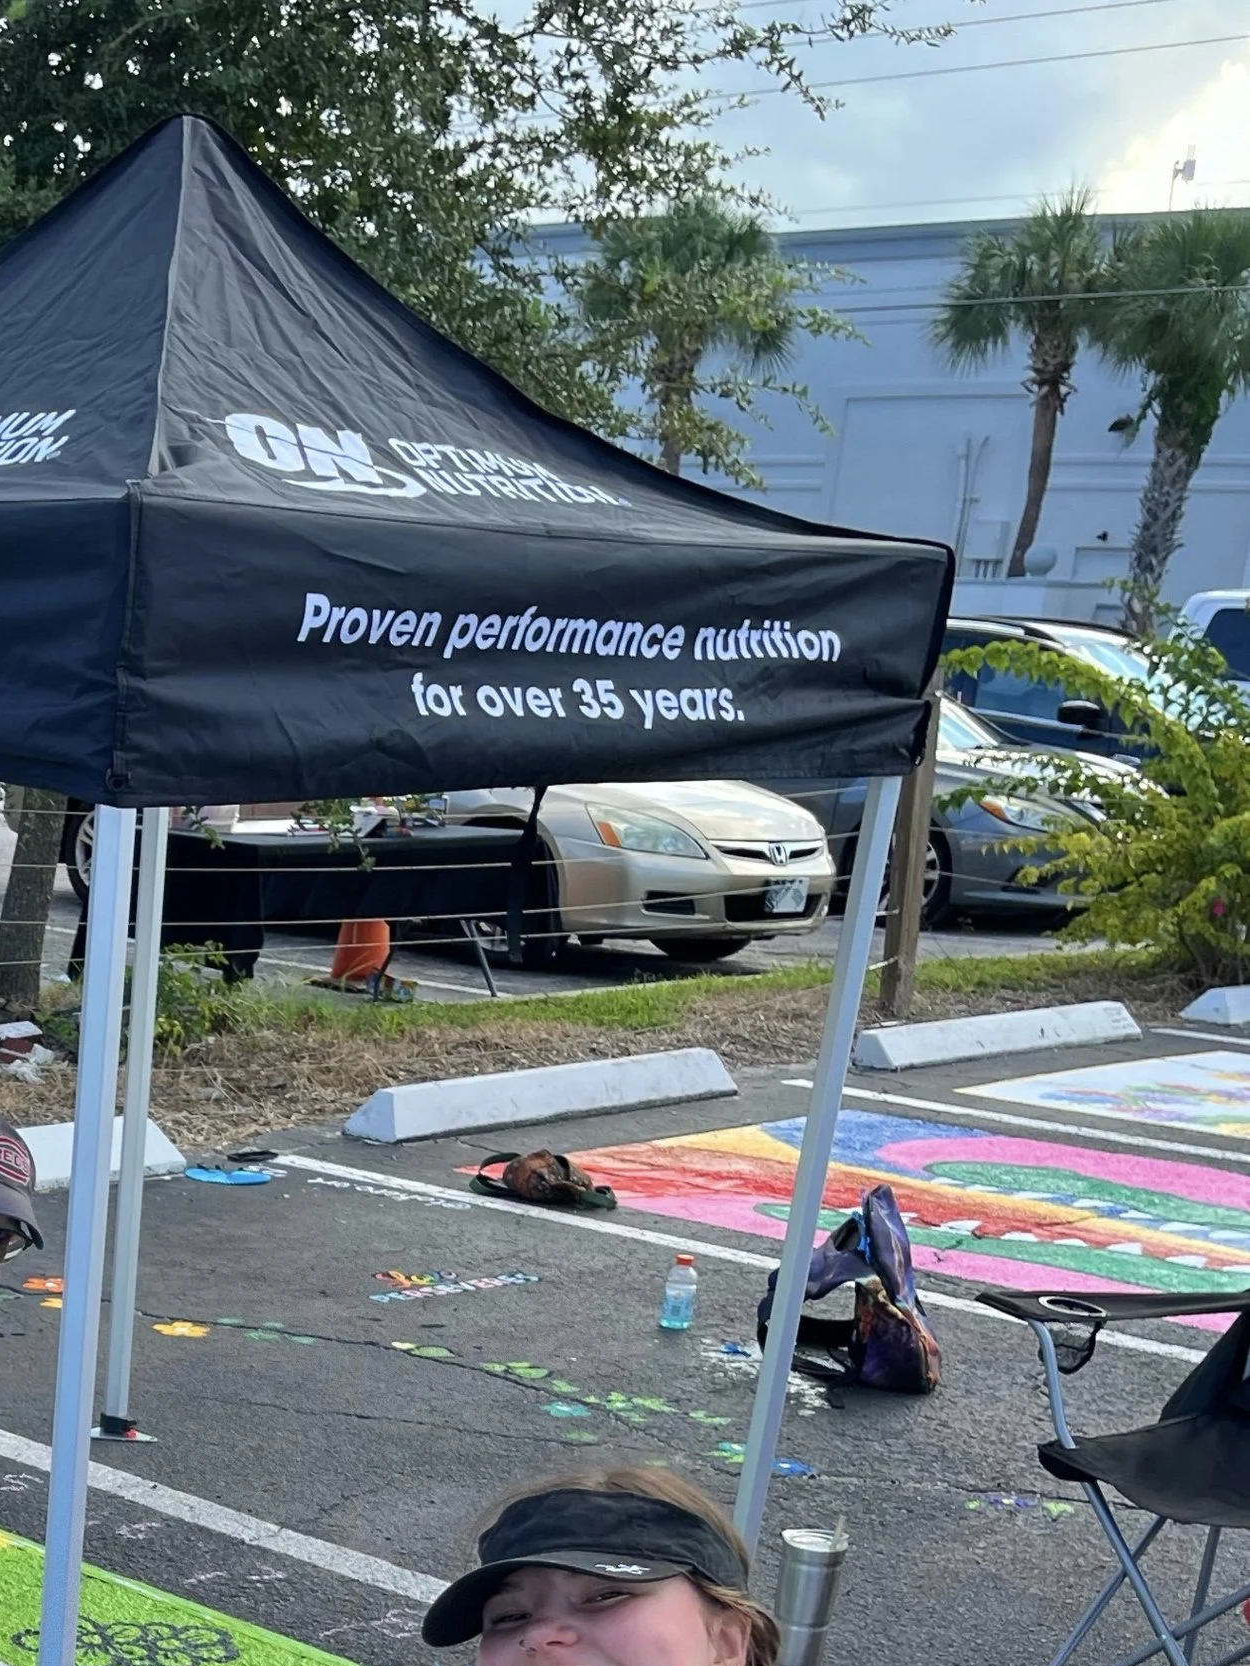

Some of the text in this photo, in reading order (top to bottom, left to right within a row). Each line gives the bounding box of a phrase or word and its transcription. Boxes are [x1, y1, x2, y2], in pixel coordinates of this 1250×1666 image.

[387, 437, 558, 481] OPTIMUM
[296, 591, 842, 664] Proven performance nutrition
[411, 671, 746, 731] for over 35 years.
